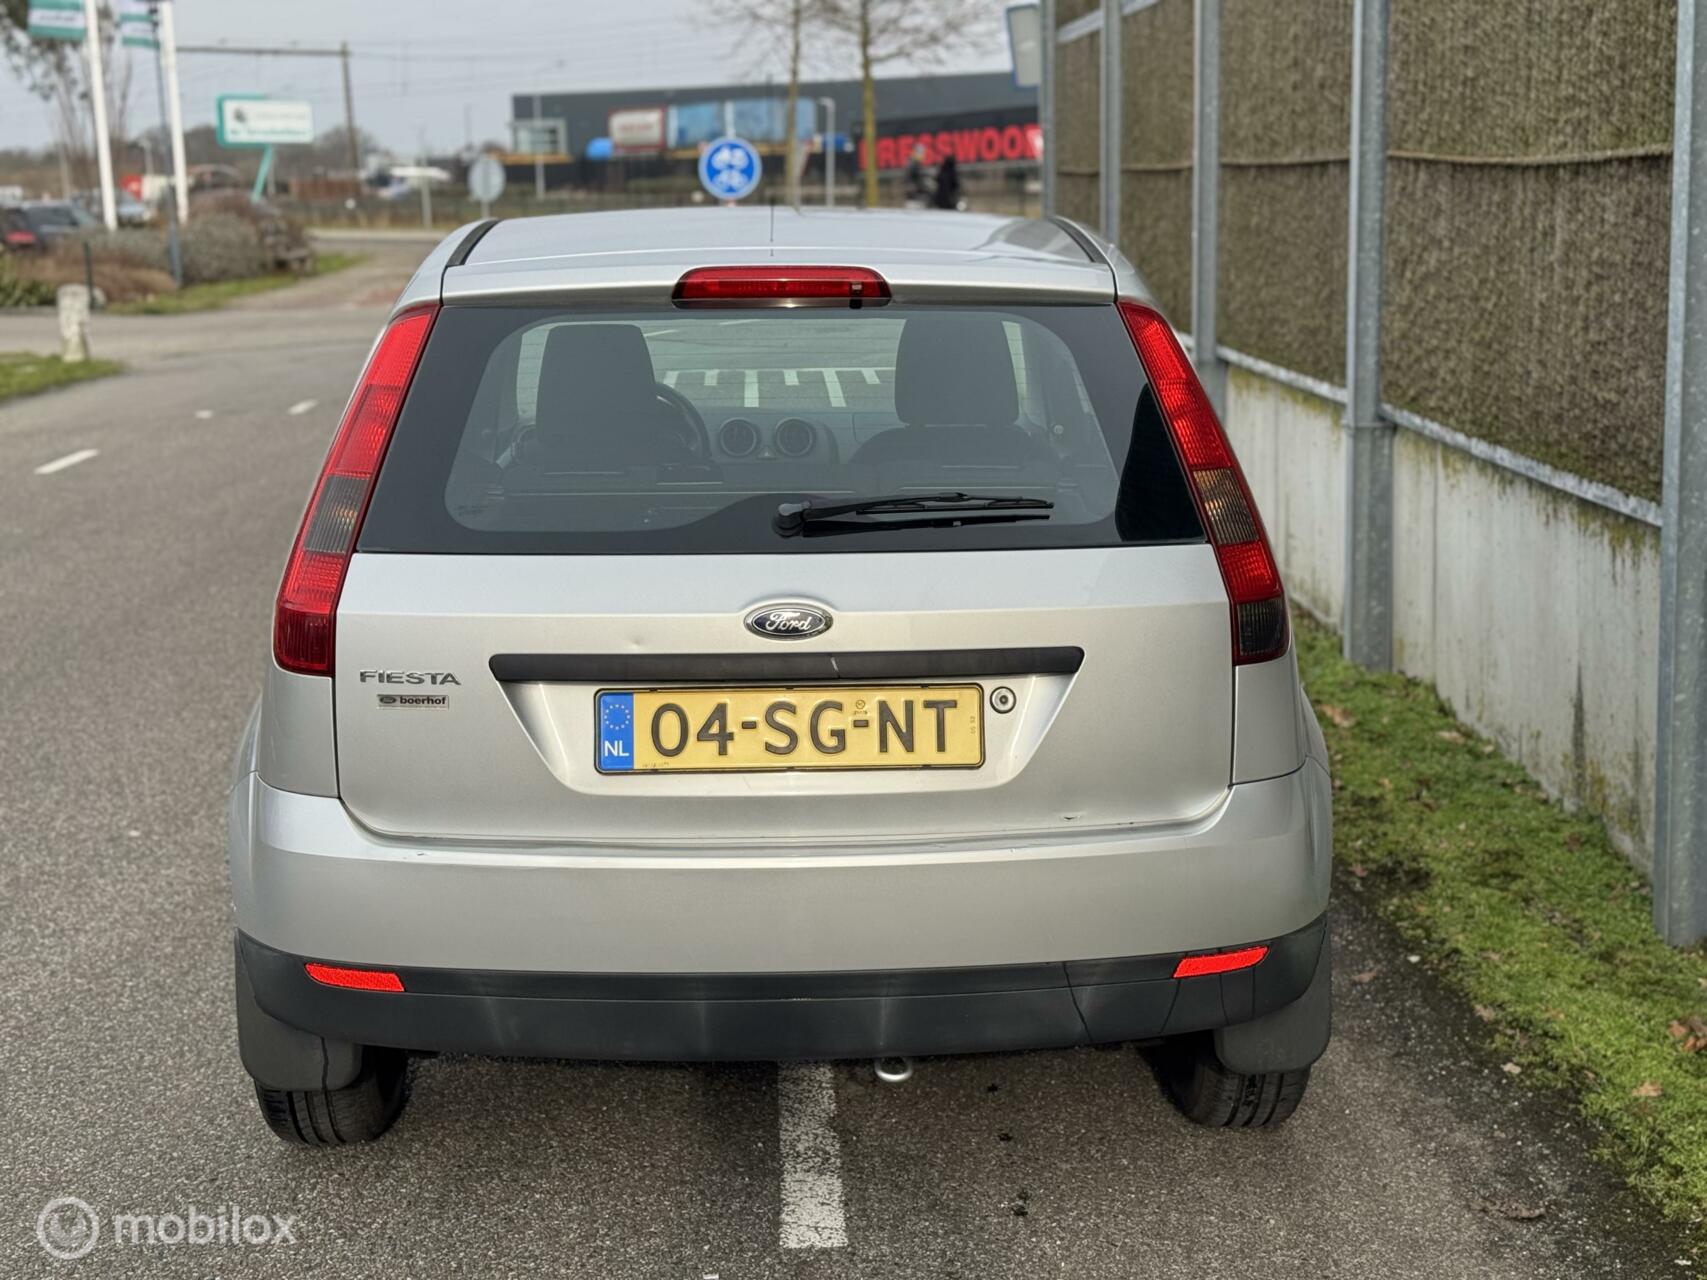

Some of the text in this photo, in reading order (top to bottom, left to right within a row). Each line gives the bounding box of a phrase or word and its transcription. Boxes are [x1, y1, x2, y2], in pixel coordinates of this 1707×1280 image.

[765, 611, 813, 631] Ford
[359, 670, 462, 686] FIESTA
[400, 695, 446, 705] boerhof
[650, 699, 958, 758] 04-SG-NT
[604, 740, 630, 757] NL
